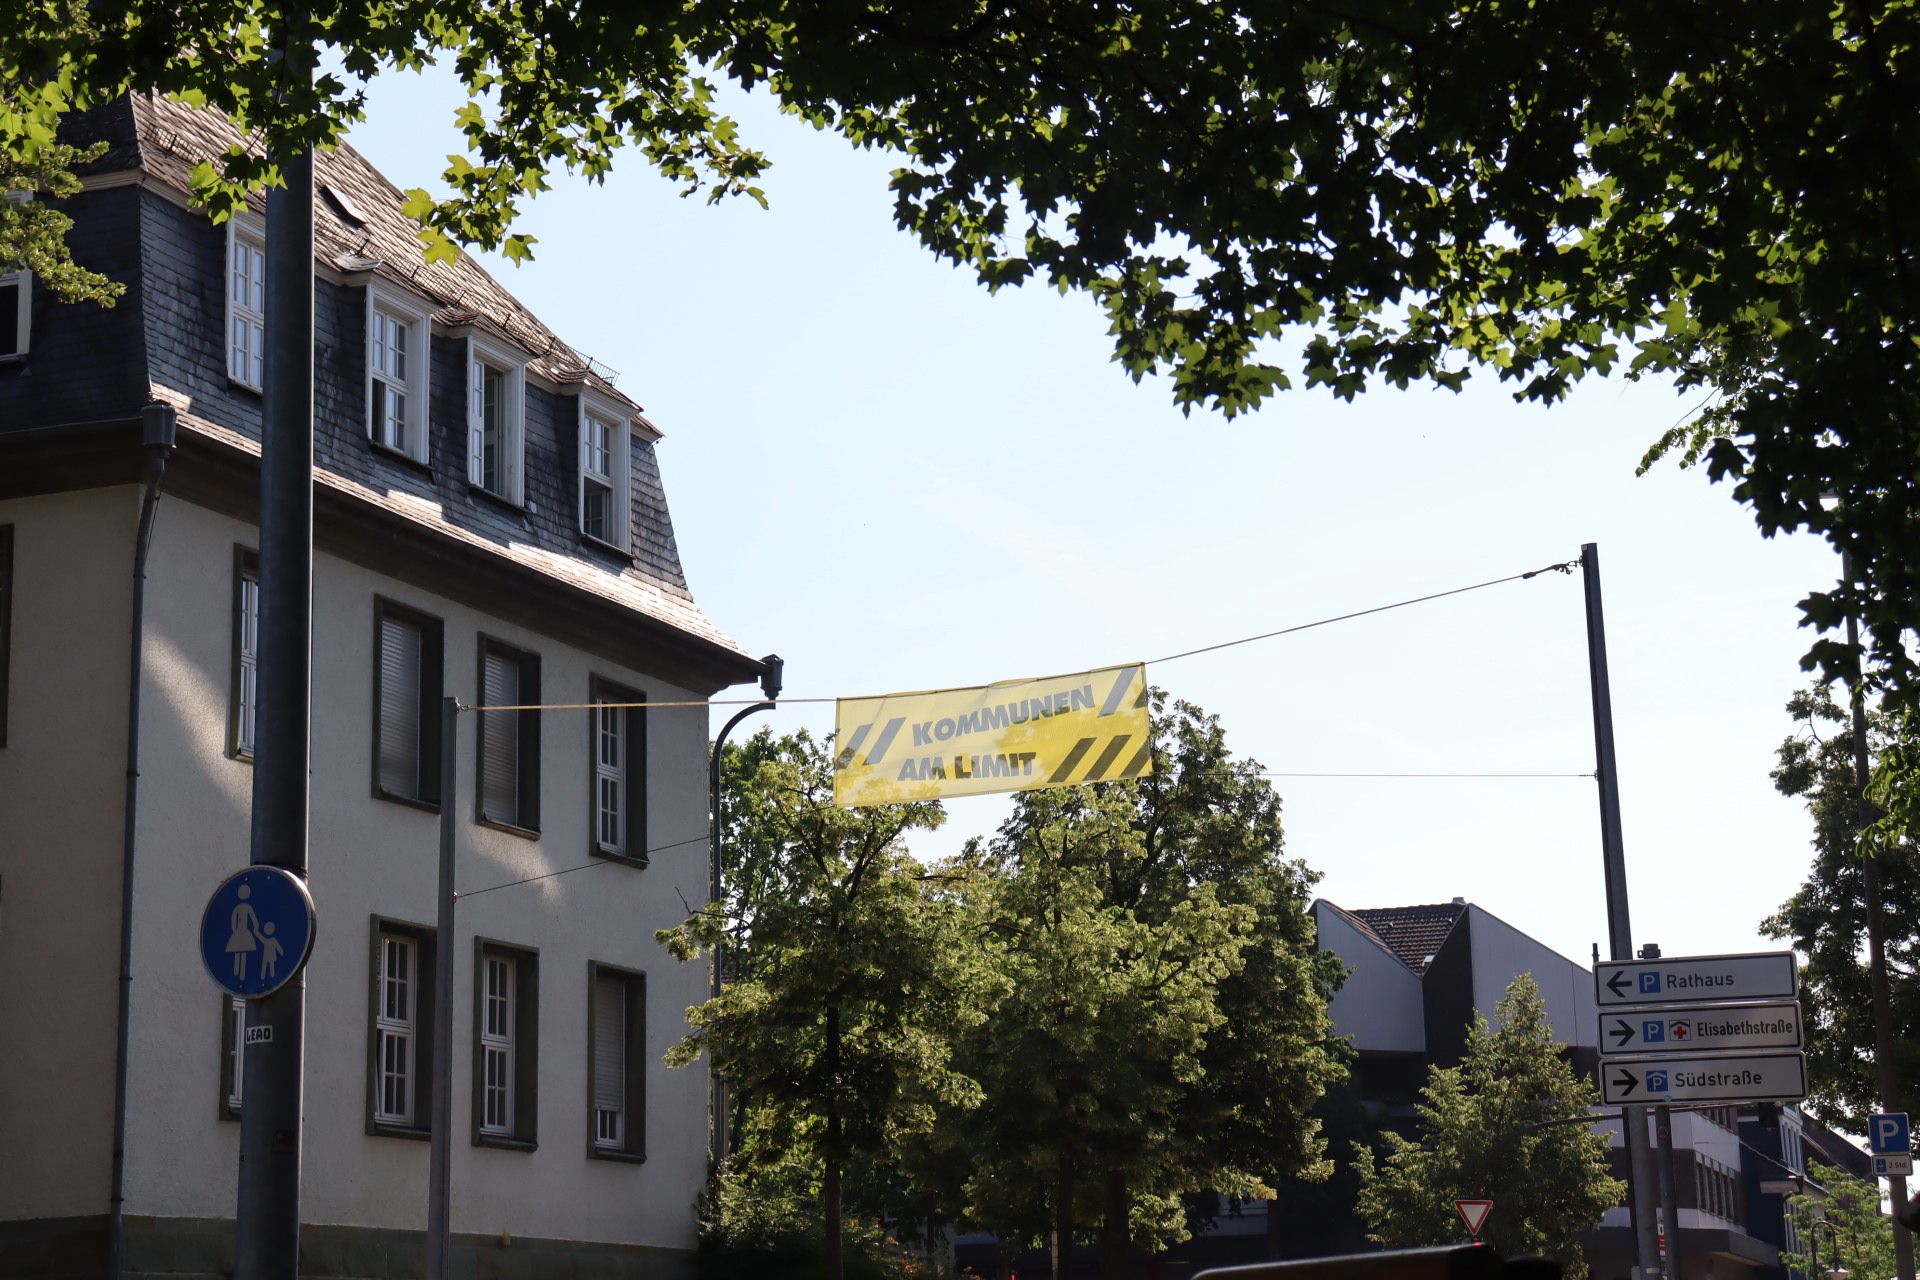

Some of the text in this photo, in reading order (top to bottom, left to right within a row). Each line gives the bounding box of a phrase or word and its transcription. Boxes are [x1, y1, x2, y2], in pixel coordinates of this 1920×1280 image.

[912, 685, 1095, 746] KOMMUNEN
[897, 752, 1037, 781] AM LIMIT
[1643, 973, 1735, 990] P Rathaus
[1647, 1019, 1793, 1040] P Elisabethstraße
[1652, 1070, 1763, 1091] P Südstraße
[1878, 1119, 1899, 1148] P
[1888, 1161, 1893, 1169] 2
